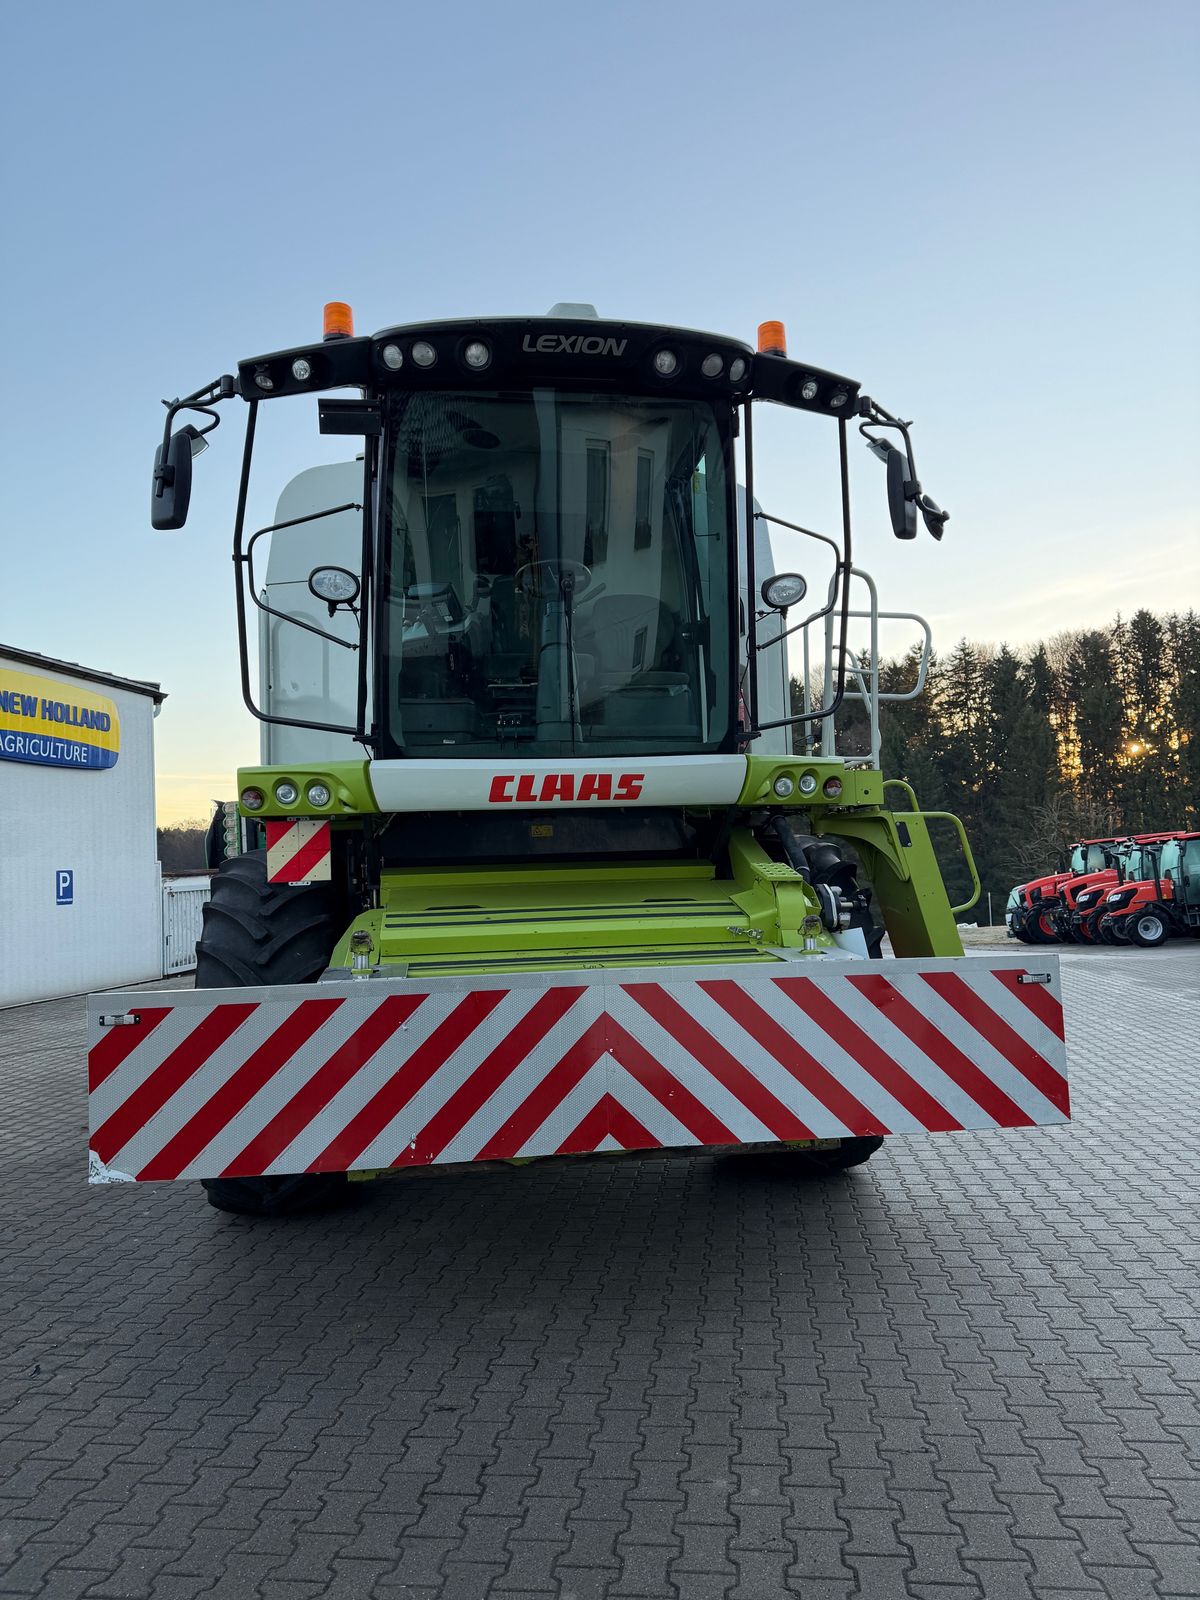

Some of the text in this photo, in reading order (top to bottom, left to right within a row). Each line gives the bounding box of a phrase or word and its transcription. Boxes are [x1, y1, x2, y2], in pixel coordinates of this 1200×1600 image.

[522, 334, 628, 356] LEXION
[0, 690, 111, 732] NEW HOLLAND
[488, 774, 645, 803] CLAAS
[59, 872, 71, 897] P
